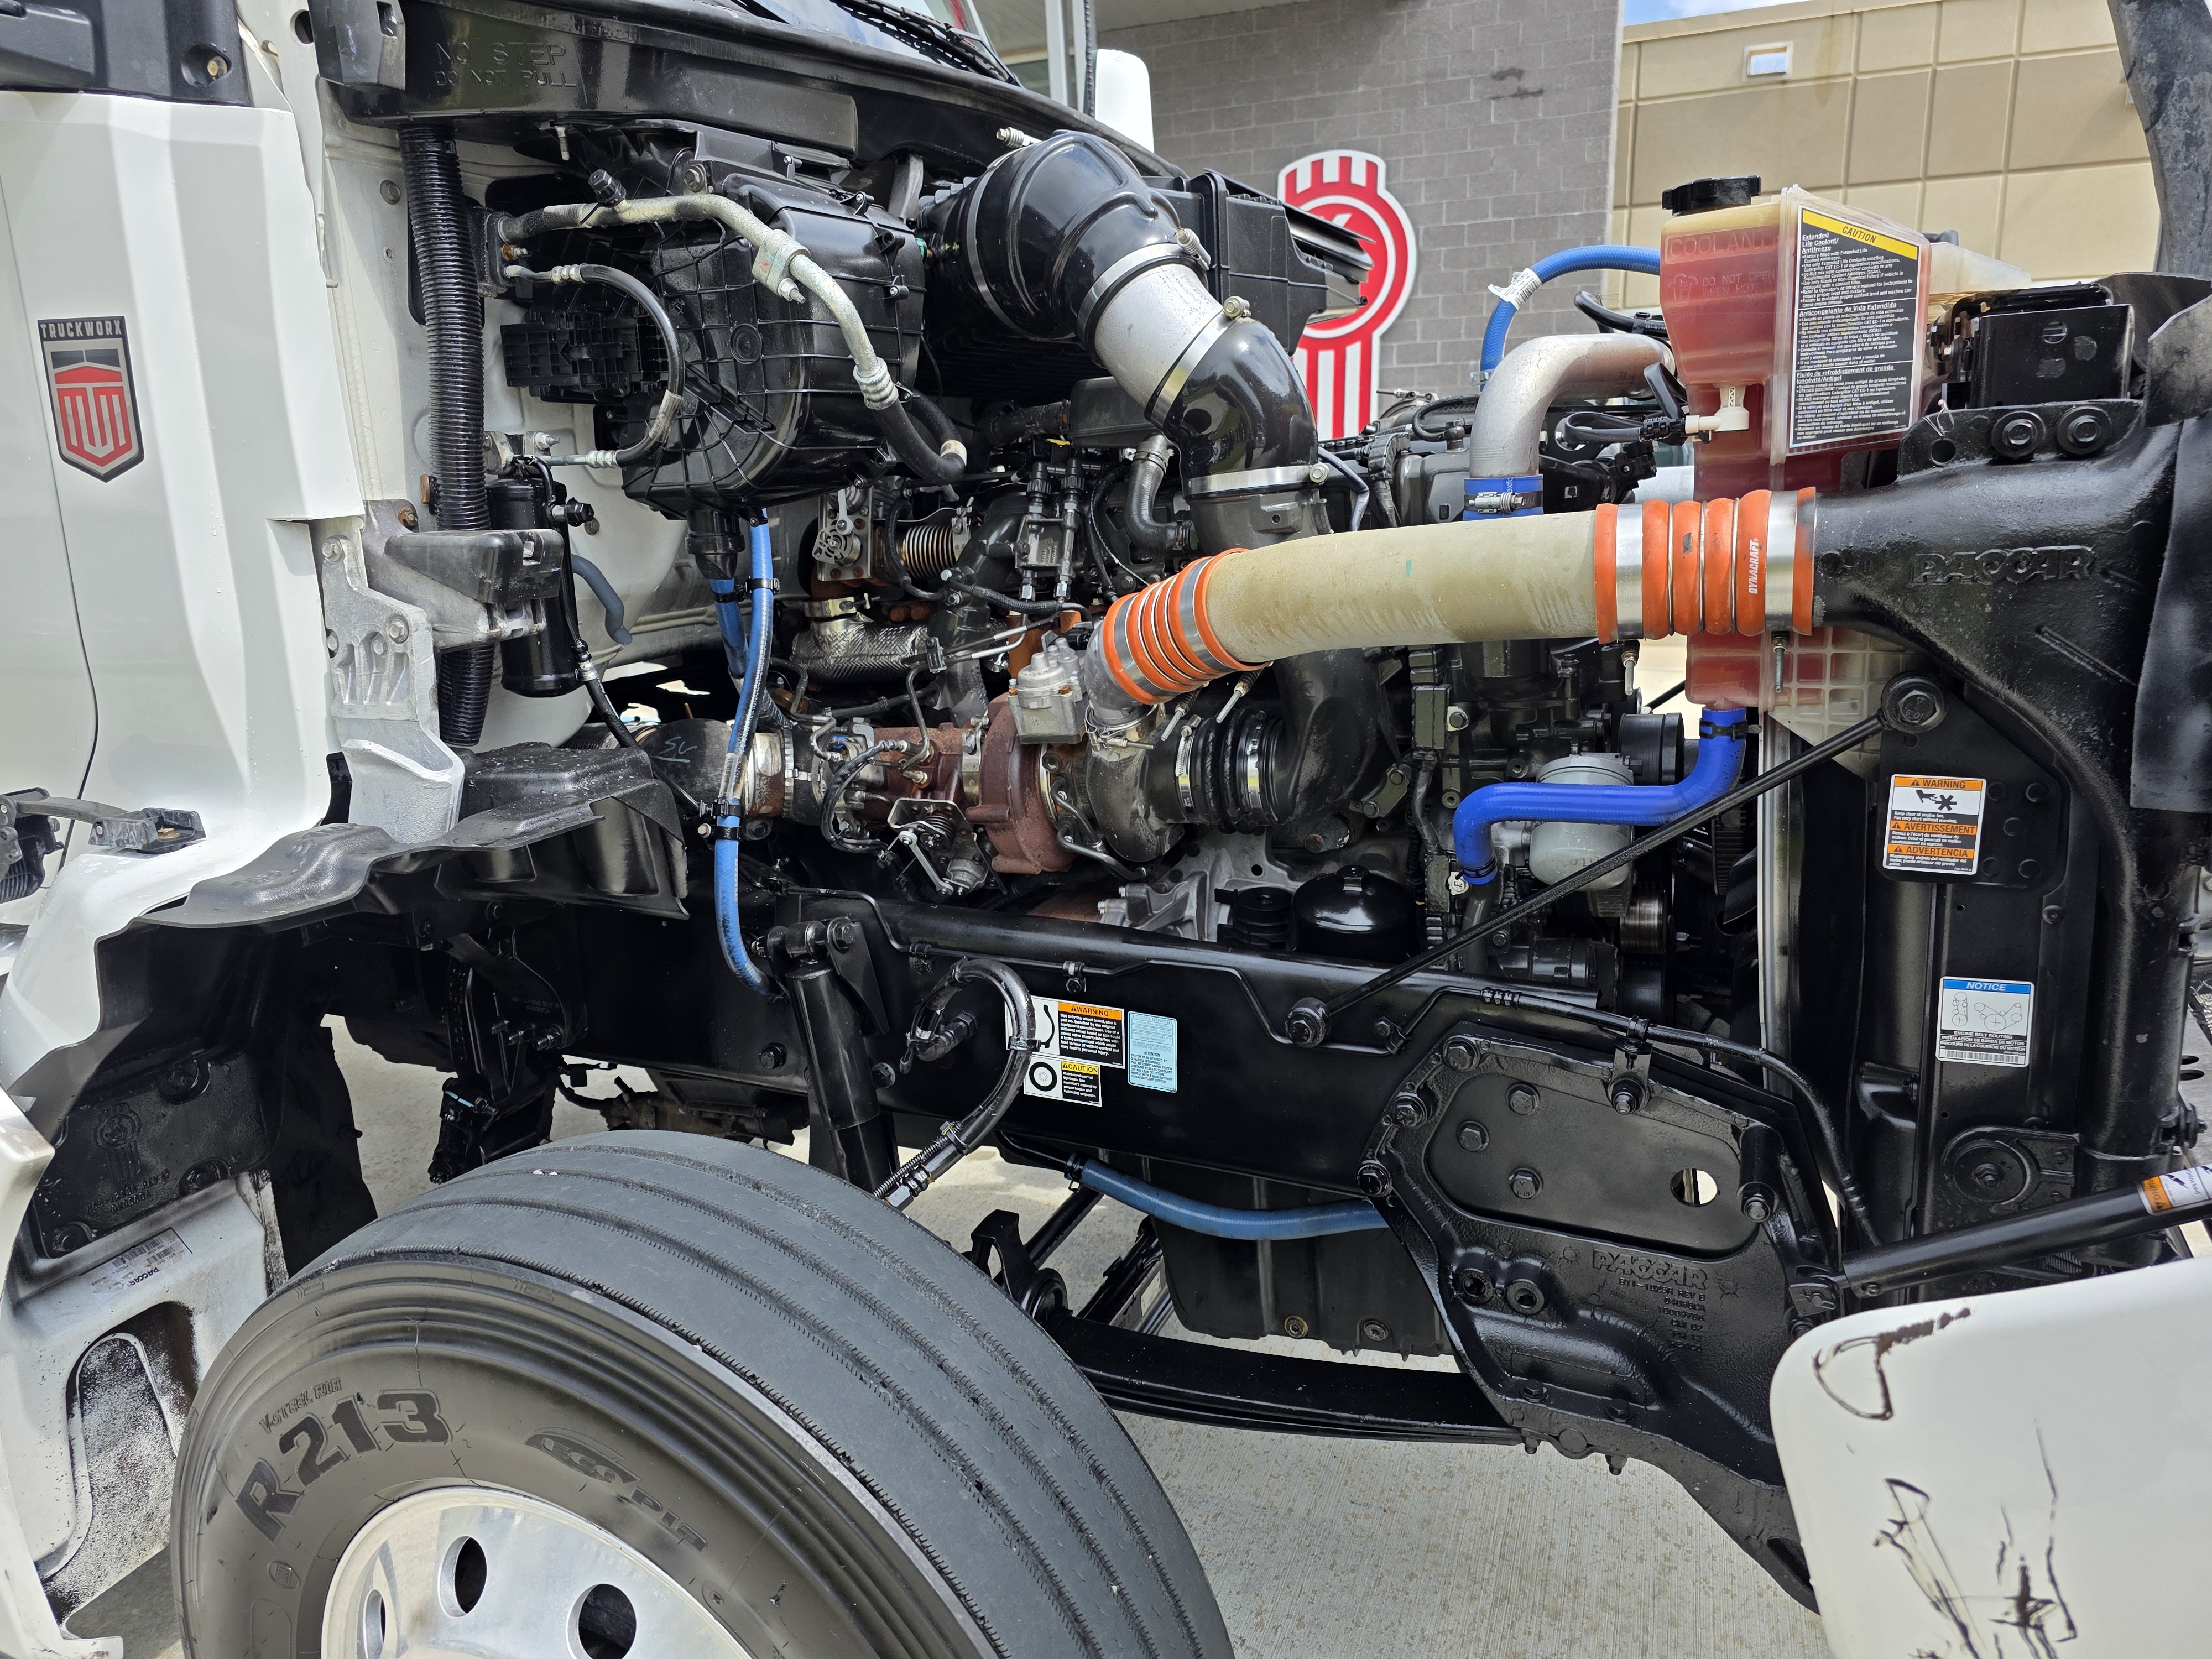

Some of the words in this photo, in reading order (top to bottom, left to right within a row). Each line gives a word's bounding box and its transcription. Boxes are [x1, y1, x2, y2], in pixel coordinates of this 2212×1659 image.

[436, 42, 471, 65] NO
[492, 42, 566, 66] STEP
[435, 71, 458, 86] DO
[472, 70, 507, 86] NOT
[522, 70, 577, 87] PULL
[1842, 226, 1877, 243] CAUTION
[1671, 230, 1770, 256] COOLANT
[1702, 276, 1716, 287] DO
[1722, 273, 1742, 283] NOT
[1749, 272, 1776, 281] OPEN
[1702, 286, 1729, 297] WHEN
[1736, 283, 1756, 294] HOT
[1799, 308, 1843, 317] Anticongelante
[40, 320, 123, 338] TRUCKWORX
[1797, 375, 1841, 384] longévité/Antigel
[1747, 540, 1760, 594] DYNACRAFT
[1910, 545, 2095, 586] PACCAR
[1923, 779, 1965, 789] WARNING
[1904, 823, 1975, 834] AVERTISSEMENT
[1906, 846, 1968, 857] ADVERTENCIA
[1966, 982, 2007, 991] NOTICE
[1077, 1006, 1109, 1016] WARNING
[1068, 1064, 1098, 1073] CAUTION
[129, 1267, 159, 1286] PACCAR
[1592, 1249, 1707, 1290] PACCAR
